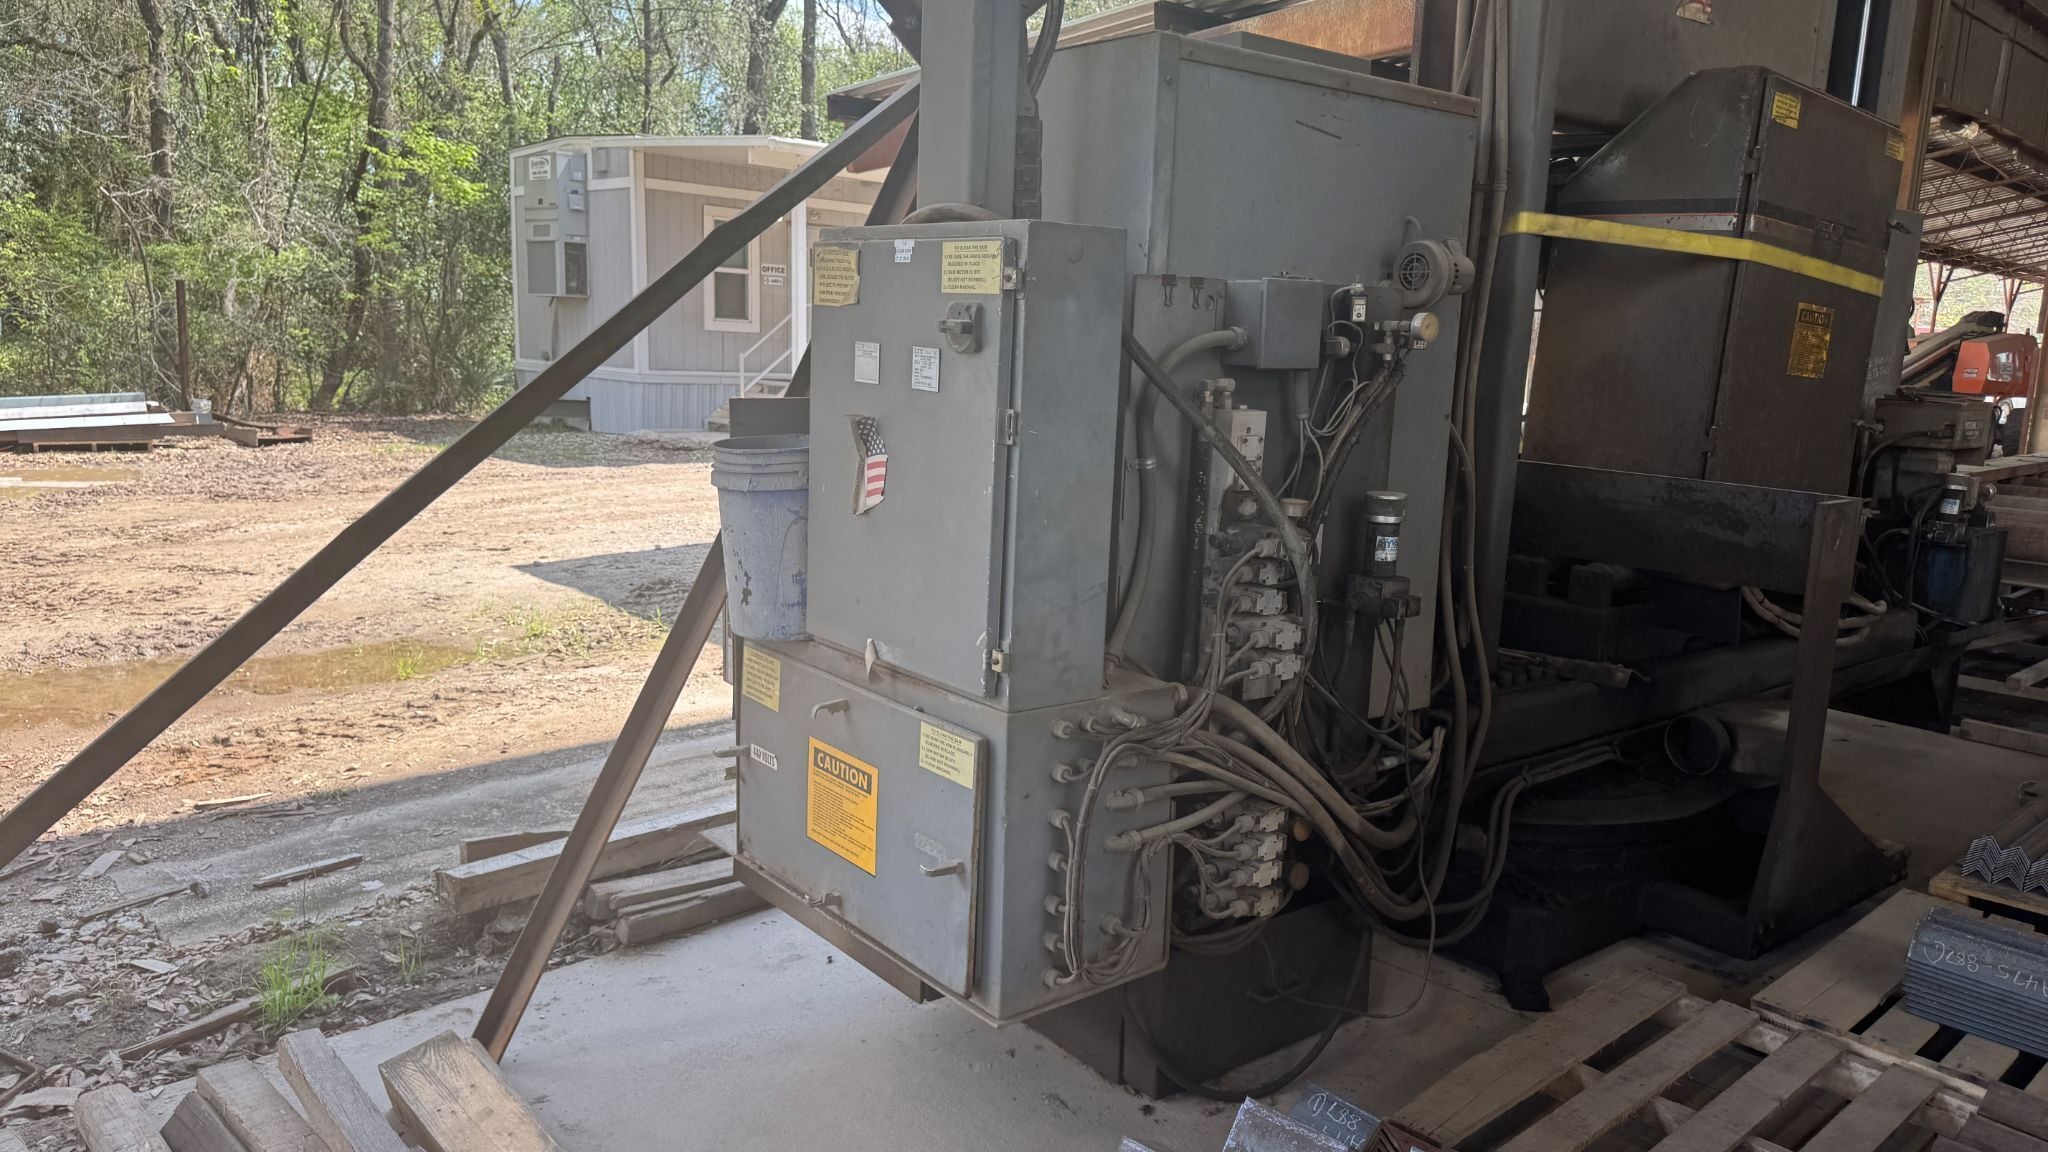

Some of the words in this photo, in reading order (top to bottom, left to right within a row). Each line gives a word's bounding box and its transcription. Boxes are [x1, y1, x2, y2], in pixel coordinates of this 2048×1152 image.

[762, 266, 785, 274] OFFICE
[1801, 311, 1829, 326] CAUTION
[761, 751, 775, 767] VOLTS
[817, 752, 869, 791] CAUTION
